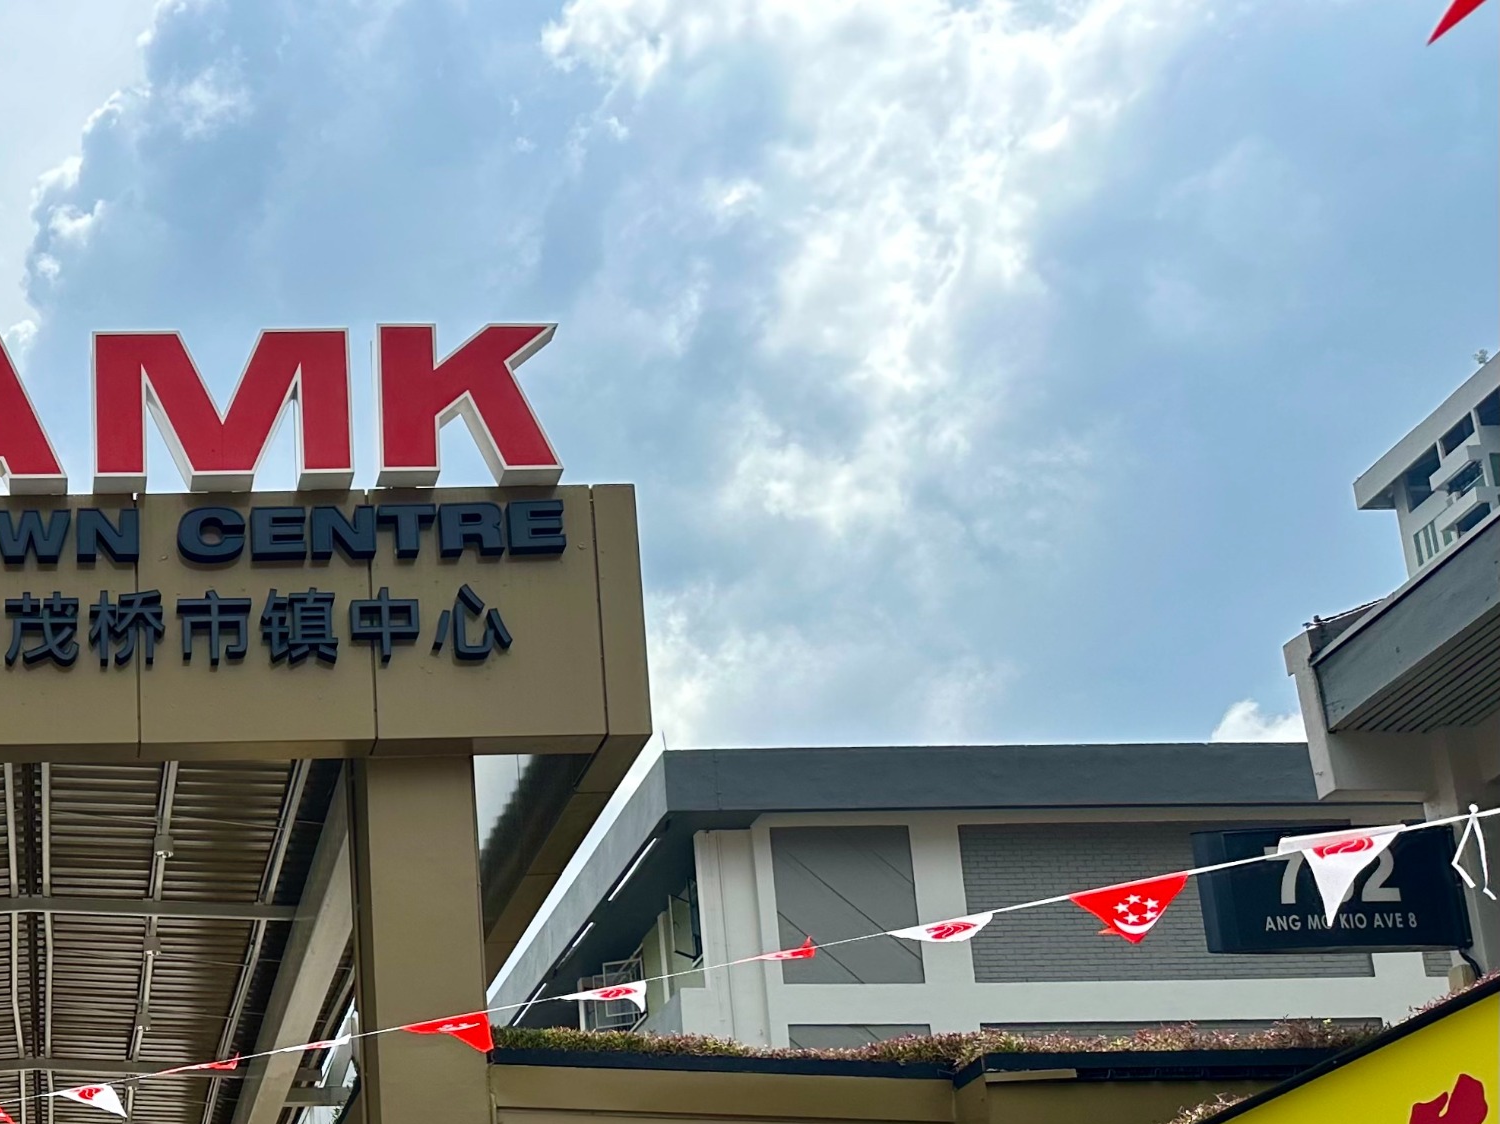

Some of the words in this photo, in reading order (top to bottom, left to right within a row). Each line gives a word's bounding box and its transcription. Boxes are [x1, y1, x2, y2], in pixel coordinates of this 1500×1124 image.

[177, 499, 567, 563] CENTRE
[1263, 846, 1402, 905] 72
[1265, 914, 1301, 932] ANG
[1339, 912, 1368, 930] KIO
[1373, 912, 1403, 929] AVE
[1408, 911, 1418, 929] 8
